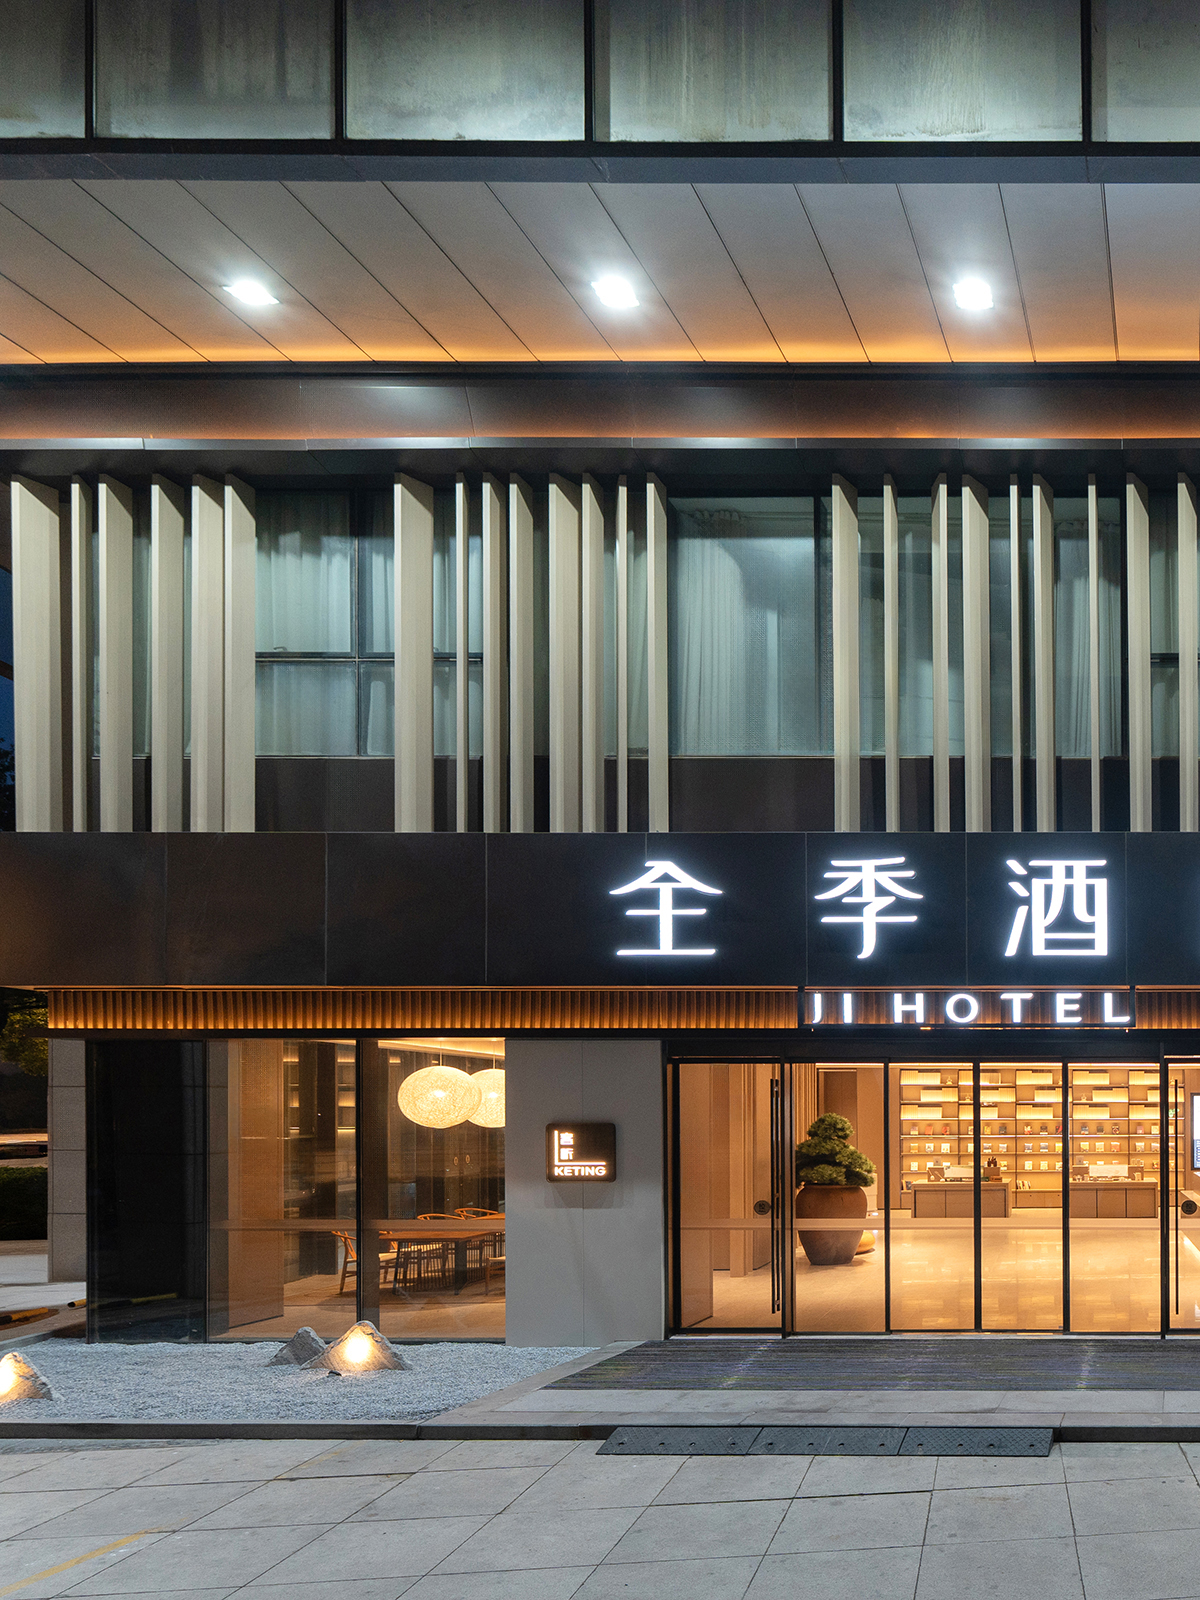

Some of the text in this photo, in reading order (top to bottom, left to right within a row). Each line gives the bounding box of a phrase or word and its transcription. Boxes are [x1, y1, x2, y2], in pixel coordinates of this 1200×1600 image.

[811, 992, 1132, 1025] JI HOTEL
[553, 1165, 607, 1177] KETING
